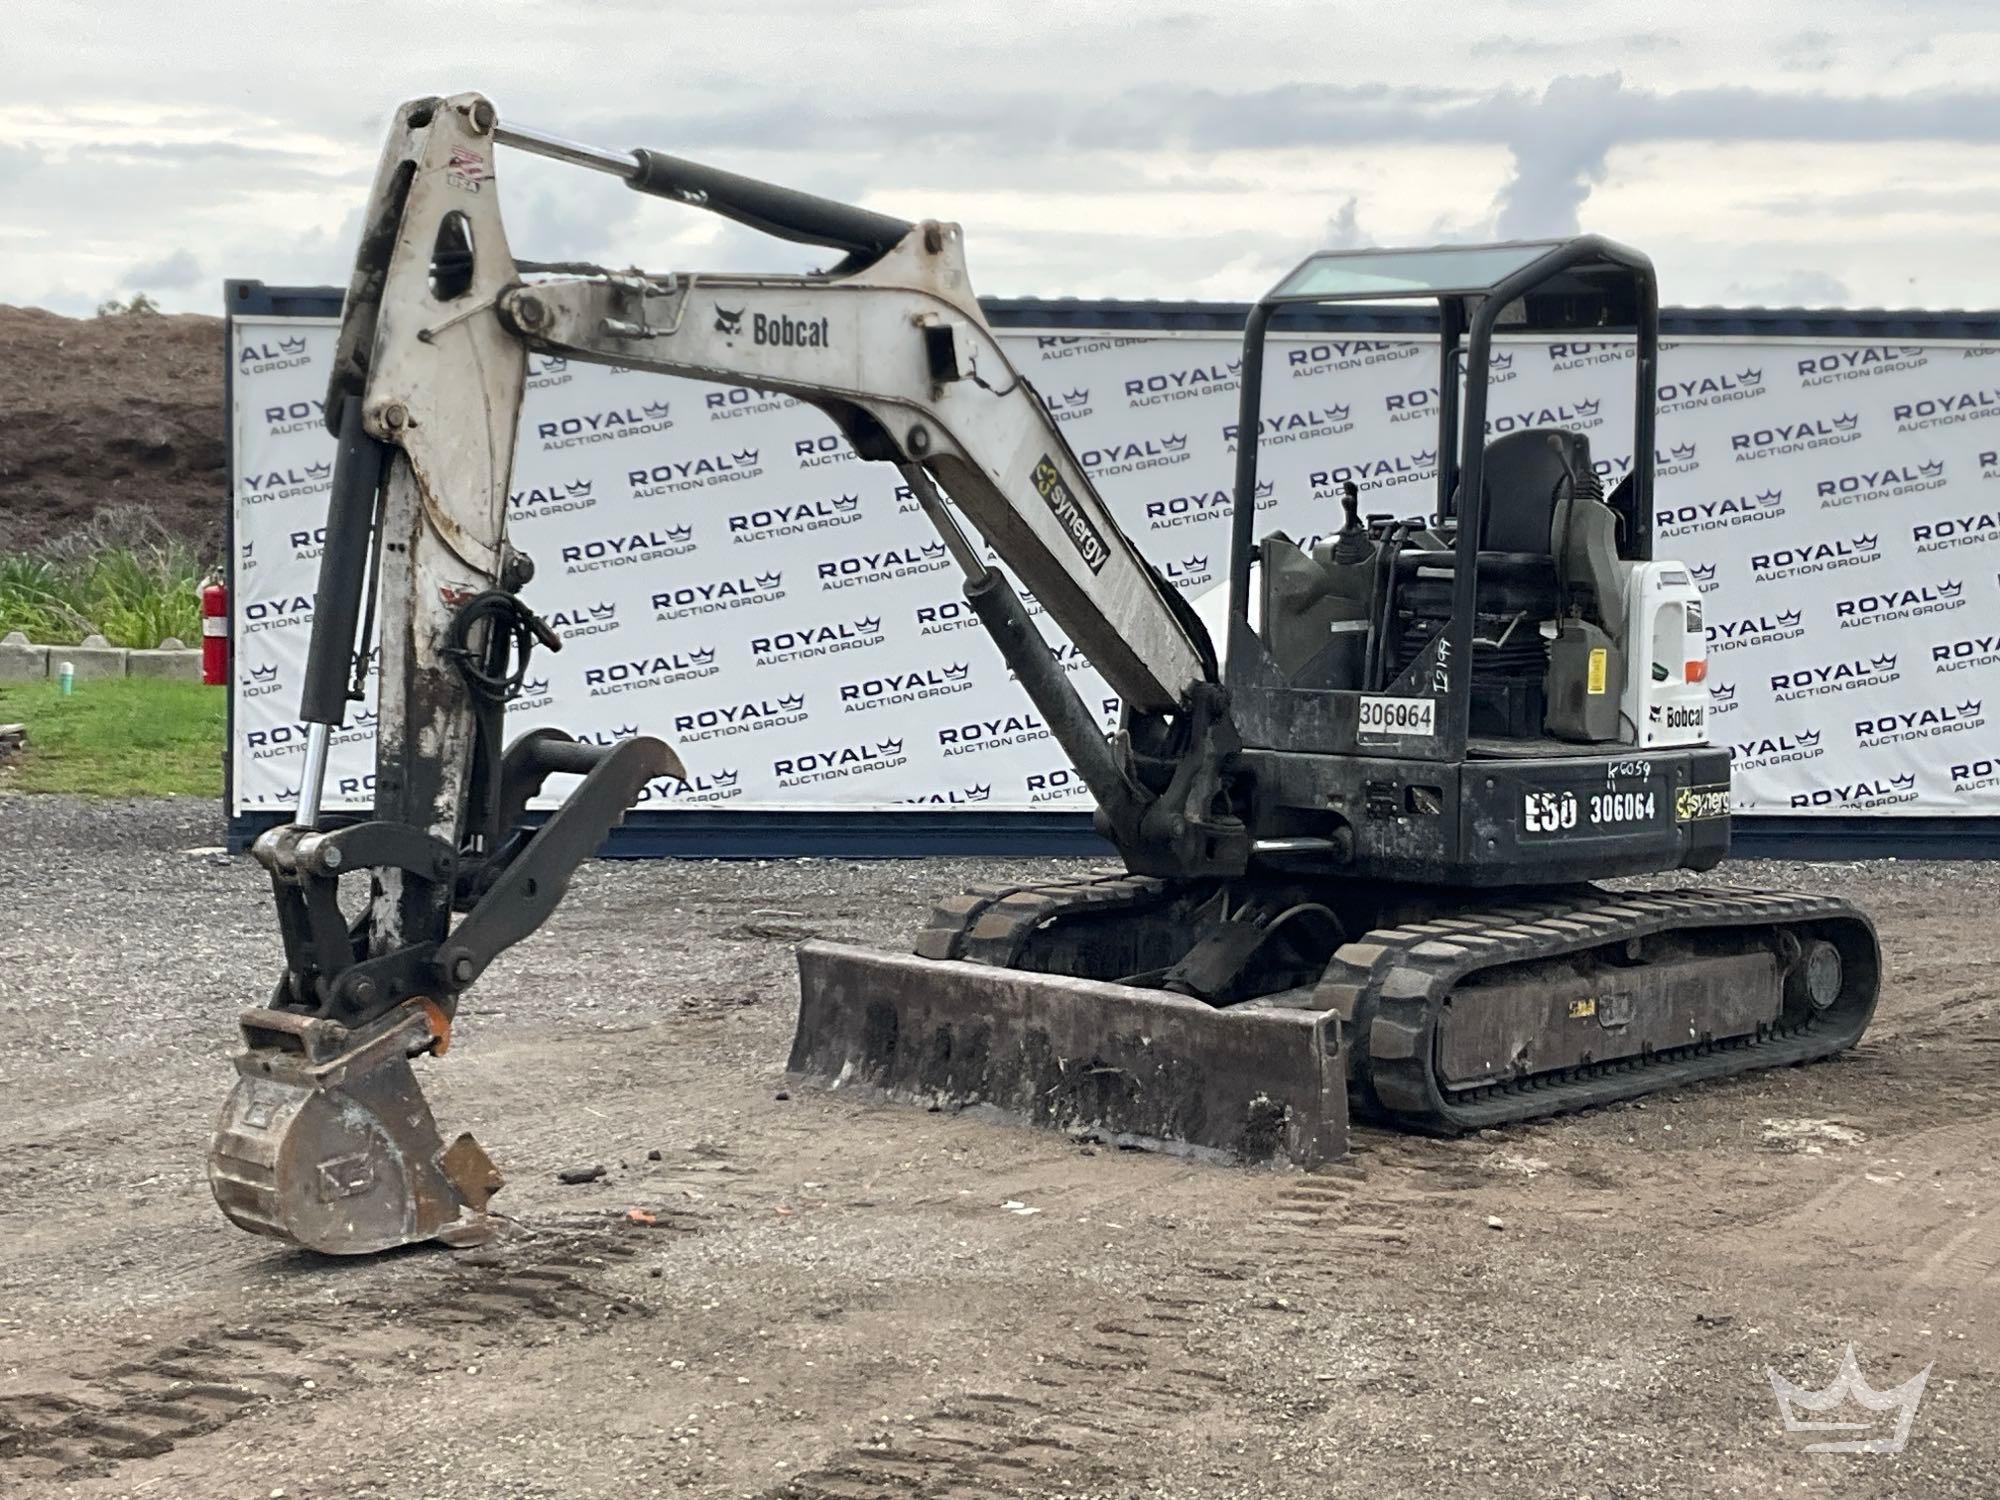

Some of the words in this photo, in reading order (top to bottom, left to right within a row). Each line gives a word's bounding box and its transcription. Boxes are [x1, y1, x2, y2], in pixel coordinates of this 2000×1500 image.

[753, 313, 829, 348] Bobcat
[253, 357, 311, 375] GROUP
[1042, 341, 1111, 361] AUCTION
[1293, 356, 1362, 378] AUCTION
[1365, 347, 1420, 364] GROUP
[1552, 352, 1622, 372] AUCTION
[1798, 347, 1898, 376] ROYAL
[526, 374, 573, 390] ROUP
[1125, 366, 1226, 396] ROYAL
[1802, 368, 1870, 388] AUCTION
[1874, 359, 1928, 375] GROUP
[1130, 388, 1198, 408] AUCTION
[1657, 376, 1736, 402] OYAL
[1710, 388, 1766, 405] GROUP
[710, 401, 782, 422] AUCTION
[1894, 392, 1993, 420] ROYAL
[538, 407, 642, 438] ROYAL
[543, 432, 614, 451] AUCTION
[617, 421, 674, 440] GROUP
[1300, 422, 1354, 440] GROUP
[1732, 419, 1832, 450] ROYAL
[1898, 414, 1966, 433] AUCTION
[1082, 440, 1161, 466] OYAL
[1137, 453, 1190, 470] GROUP
[1735, 442, 1804, 462] AUCTION
[1807, 432, 1861, 449] GROUP
[244, 468, 304, 491] YAL
[630, 455, 732, 486] ROYAL
[633, 479, 703, 499] AUCTION
[707, 468, 762, 486] GROUP
[1310, 457, 1411, 488] ROYAL
[1818, 466, 1918, 496] ROYAL
[510, 486, 565, 508] YAL
[540, 499, 596, 516] GROUP
[1147, 490, 1231, 518] ROYA
[1821, 490, 1890, 509] AUCTION
[1893, 479, 1947, 496] GROUP
[729, 500, 831, 532] ROYAL
[1051, 484, 1107, 568] synergy
[1151, 510, 1220, 530] AUCTION
[1655, 496, 1756, 526] ROYAL
[1660, 520, 1728, 538] AUCTION
[1732, 509, 1785, 525] GROUP
[734, 524, 804, 544] AUCTION
[808, 512, 862, 530] GROUP
[1913, 512, 2000, 541] ROYA
[561, 530, 665, 562] ROYAL
[566, 554, 637, 575] AUCTION
[641, 542, 697, 561] GROUP
[1751, 539, 1851, 571] ROYAL
[1917, 534, 1984, 554] AUCTION
[818, 546, 920, 578] ROYAL
[823, 570, 892, 591] AUCTION
[896, 559, 951, 577] GROUP
[1756, 563, 1824, 583] AUCTION
[1828, 552, 1881, 569] GROUP
[246, 596, 314, 620] OYA
[652, 578, 754, 610] ROYAL
[657, 602, 726, 622] AUCTION
[730, 590, 785, 608] GROUP
[1836, 587, 1937, 616] ROYAL
[1840, 610, 1908, 629] AUCTION
[1912, 600, 1966, 616] GROUP
[564, 622, 620, 640] GROUP
[750, 622, 854, 654] ROYAL
[1751, 629, 1805, 646] GROUP
[755, 646, 826, 667] AUCTION
[830, 634, 886, 653] GROUP
[584, 653, 688, 685] ROYAL
[589, 677, 660, 698] AUCTION
[664, 665, 720, 684] GROUP
[840, 668, 942, 700] ROYAL
[1770, 659, 1870, 691] ROYAL
[845, 692, 914, 713] AUCTION
[918, 681, 973, 699] GROUP
[1775, 683, 1843, 703] AUCTION
[1847, 672, 1900, 689] GROUP
[675, 700, 777, 732] ROYAL
[680, 724, 750, 744] AUCTION
[754, 712, 808, 730] GROUP
[939, 714, 1041, 745] ROYAL
[1360, 702, 1432, 729] 306064
[1667, 705, 1704, 728] Bobcat
[1855, 705, 1955, 737] ROYAL
[943, 738, 1012, 757] AUCTION
[1860, 729, 1928, 749] AUCTION
[1932, 718, 1985, 735] GROUP
[774, 744, 876, 776] ROYAL
[779, 768, 848, 788] AUCTION
[852, 756, 907, 774] GROUP
[1770, 748, 1824, 766] GROUP
[1030, 784, 1088, 803] AUCTIO
[1590, 792, 1655, 823] 306064
[1691, 790, 1730, 817] synerg
[1791, 780, 1890, 808] ROYAL
